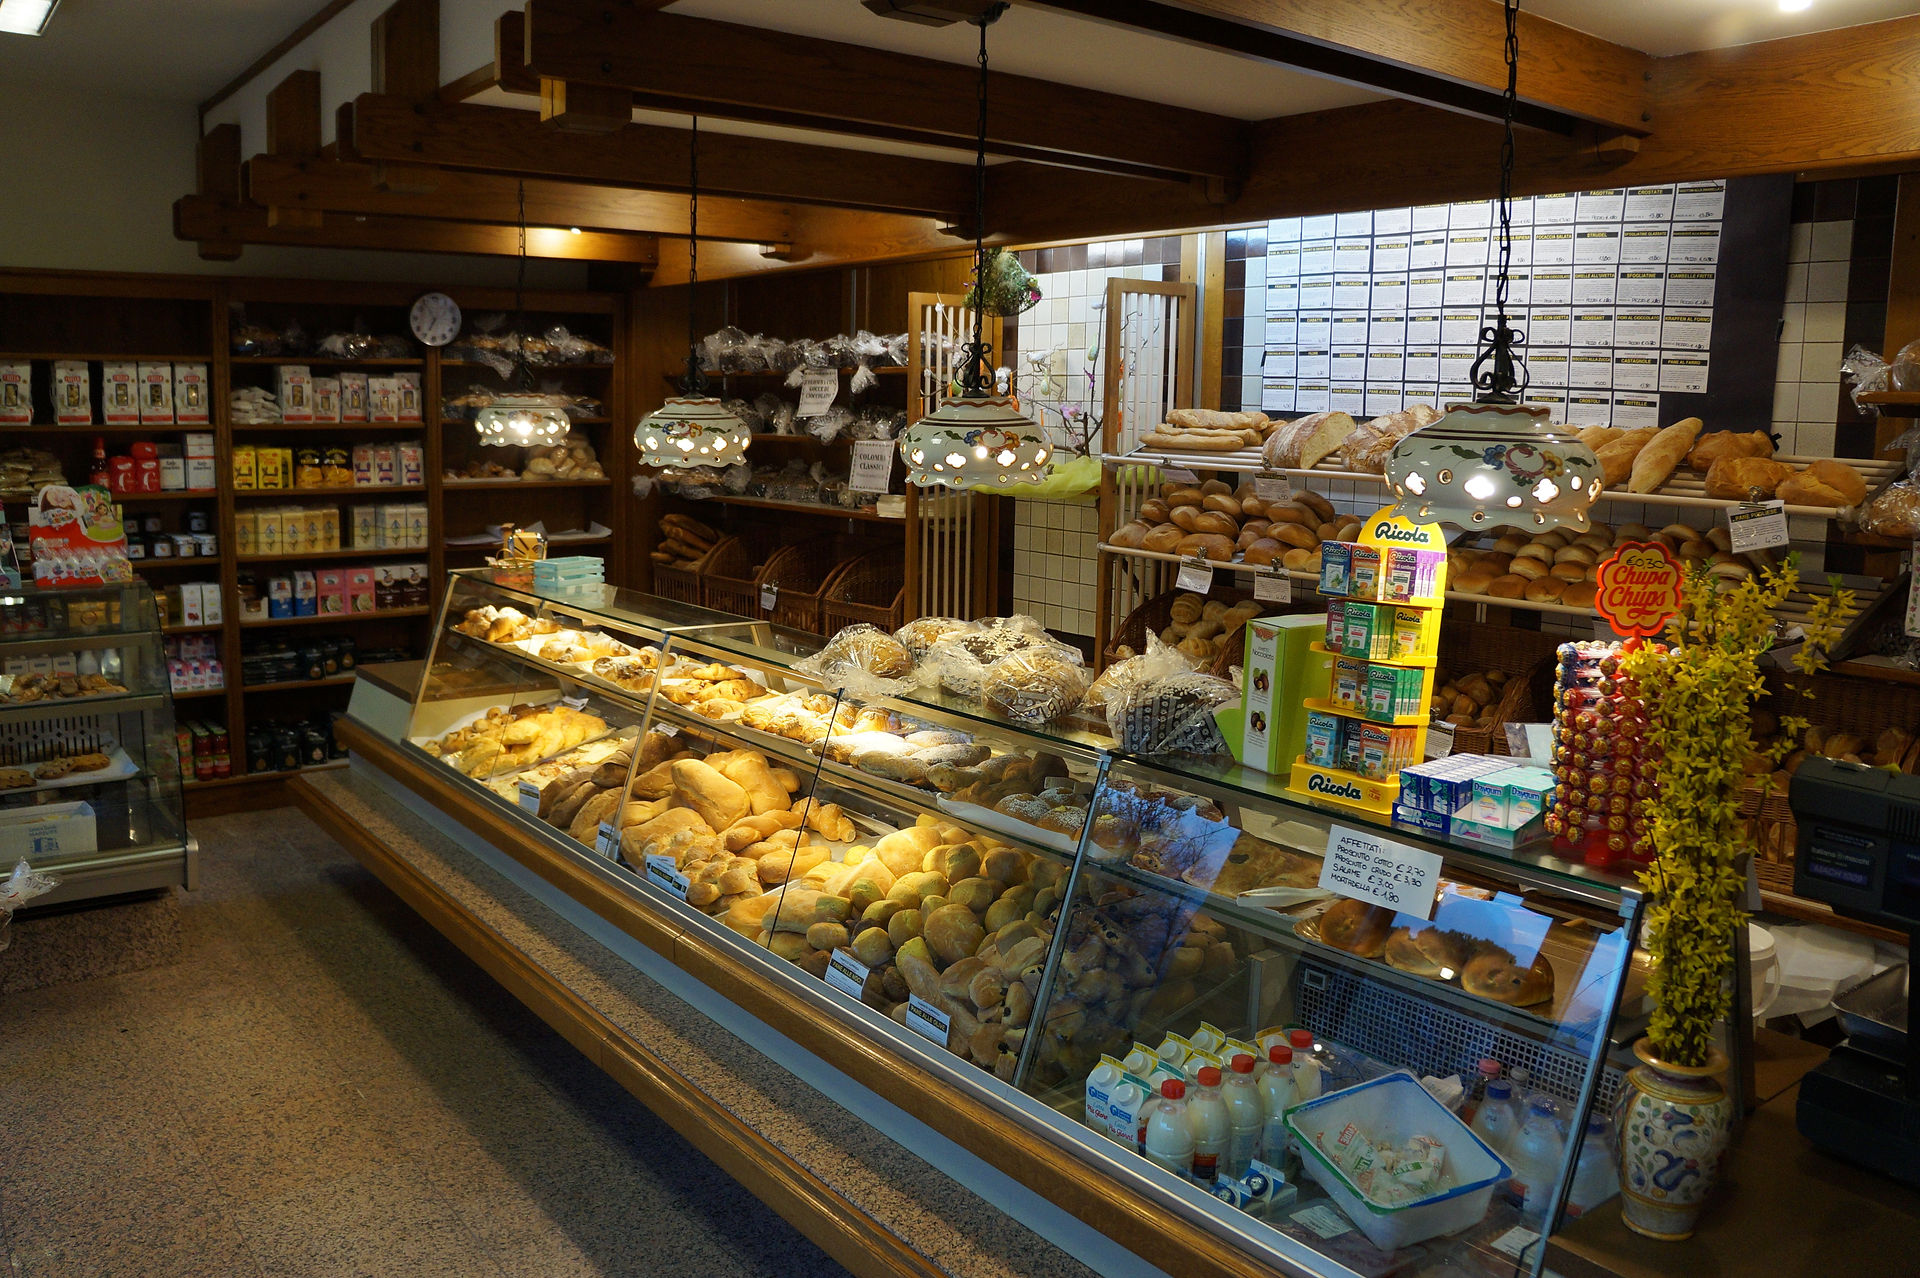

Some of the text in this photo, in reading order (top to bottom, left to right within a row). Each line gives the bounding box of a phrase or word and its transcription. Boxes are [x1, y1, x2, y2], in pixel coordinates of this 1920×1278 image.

[1375, 522, 1429, 543] Ricola
[1324, 546, 1348, 556] Ricola
[1354, 550, 1379, 560] Ricola
[1390, 552, 1416, 562] Ricola
[1626, 555, 1665, 570] €0,30
[1613, 565, 1672, 590] Chupa
[1608, 586, 1668, 612] Chups
[1346, 607, 1372, 619] Ricola
[1396, 612, 1421, 624] Ricola
[1370, 670, 1396, 681] Ricola
[1310, 717, 1334, 729] Ricola
[1363, 729, 1389, 741] Ricola
[1308, 774, 1362, 800] Ricola
[1474, 783, 1502, 796] Daygum
[1512, 786, 1540, 801] Daygum
[1337, 844, 1425, 877] PROSCIUTTO COTTO € 2,70
[1333, 863, 1394, 890] SALAME € 3,00
[1335, 854, 1422, 888] PROSCIUTTO CRUDO € 3,30
[1330, 873, 1370, 892] MORTADELLA
[1372, 888, 1379, 896] €
